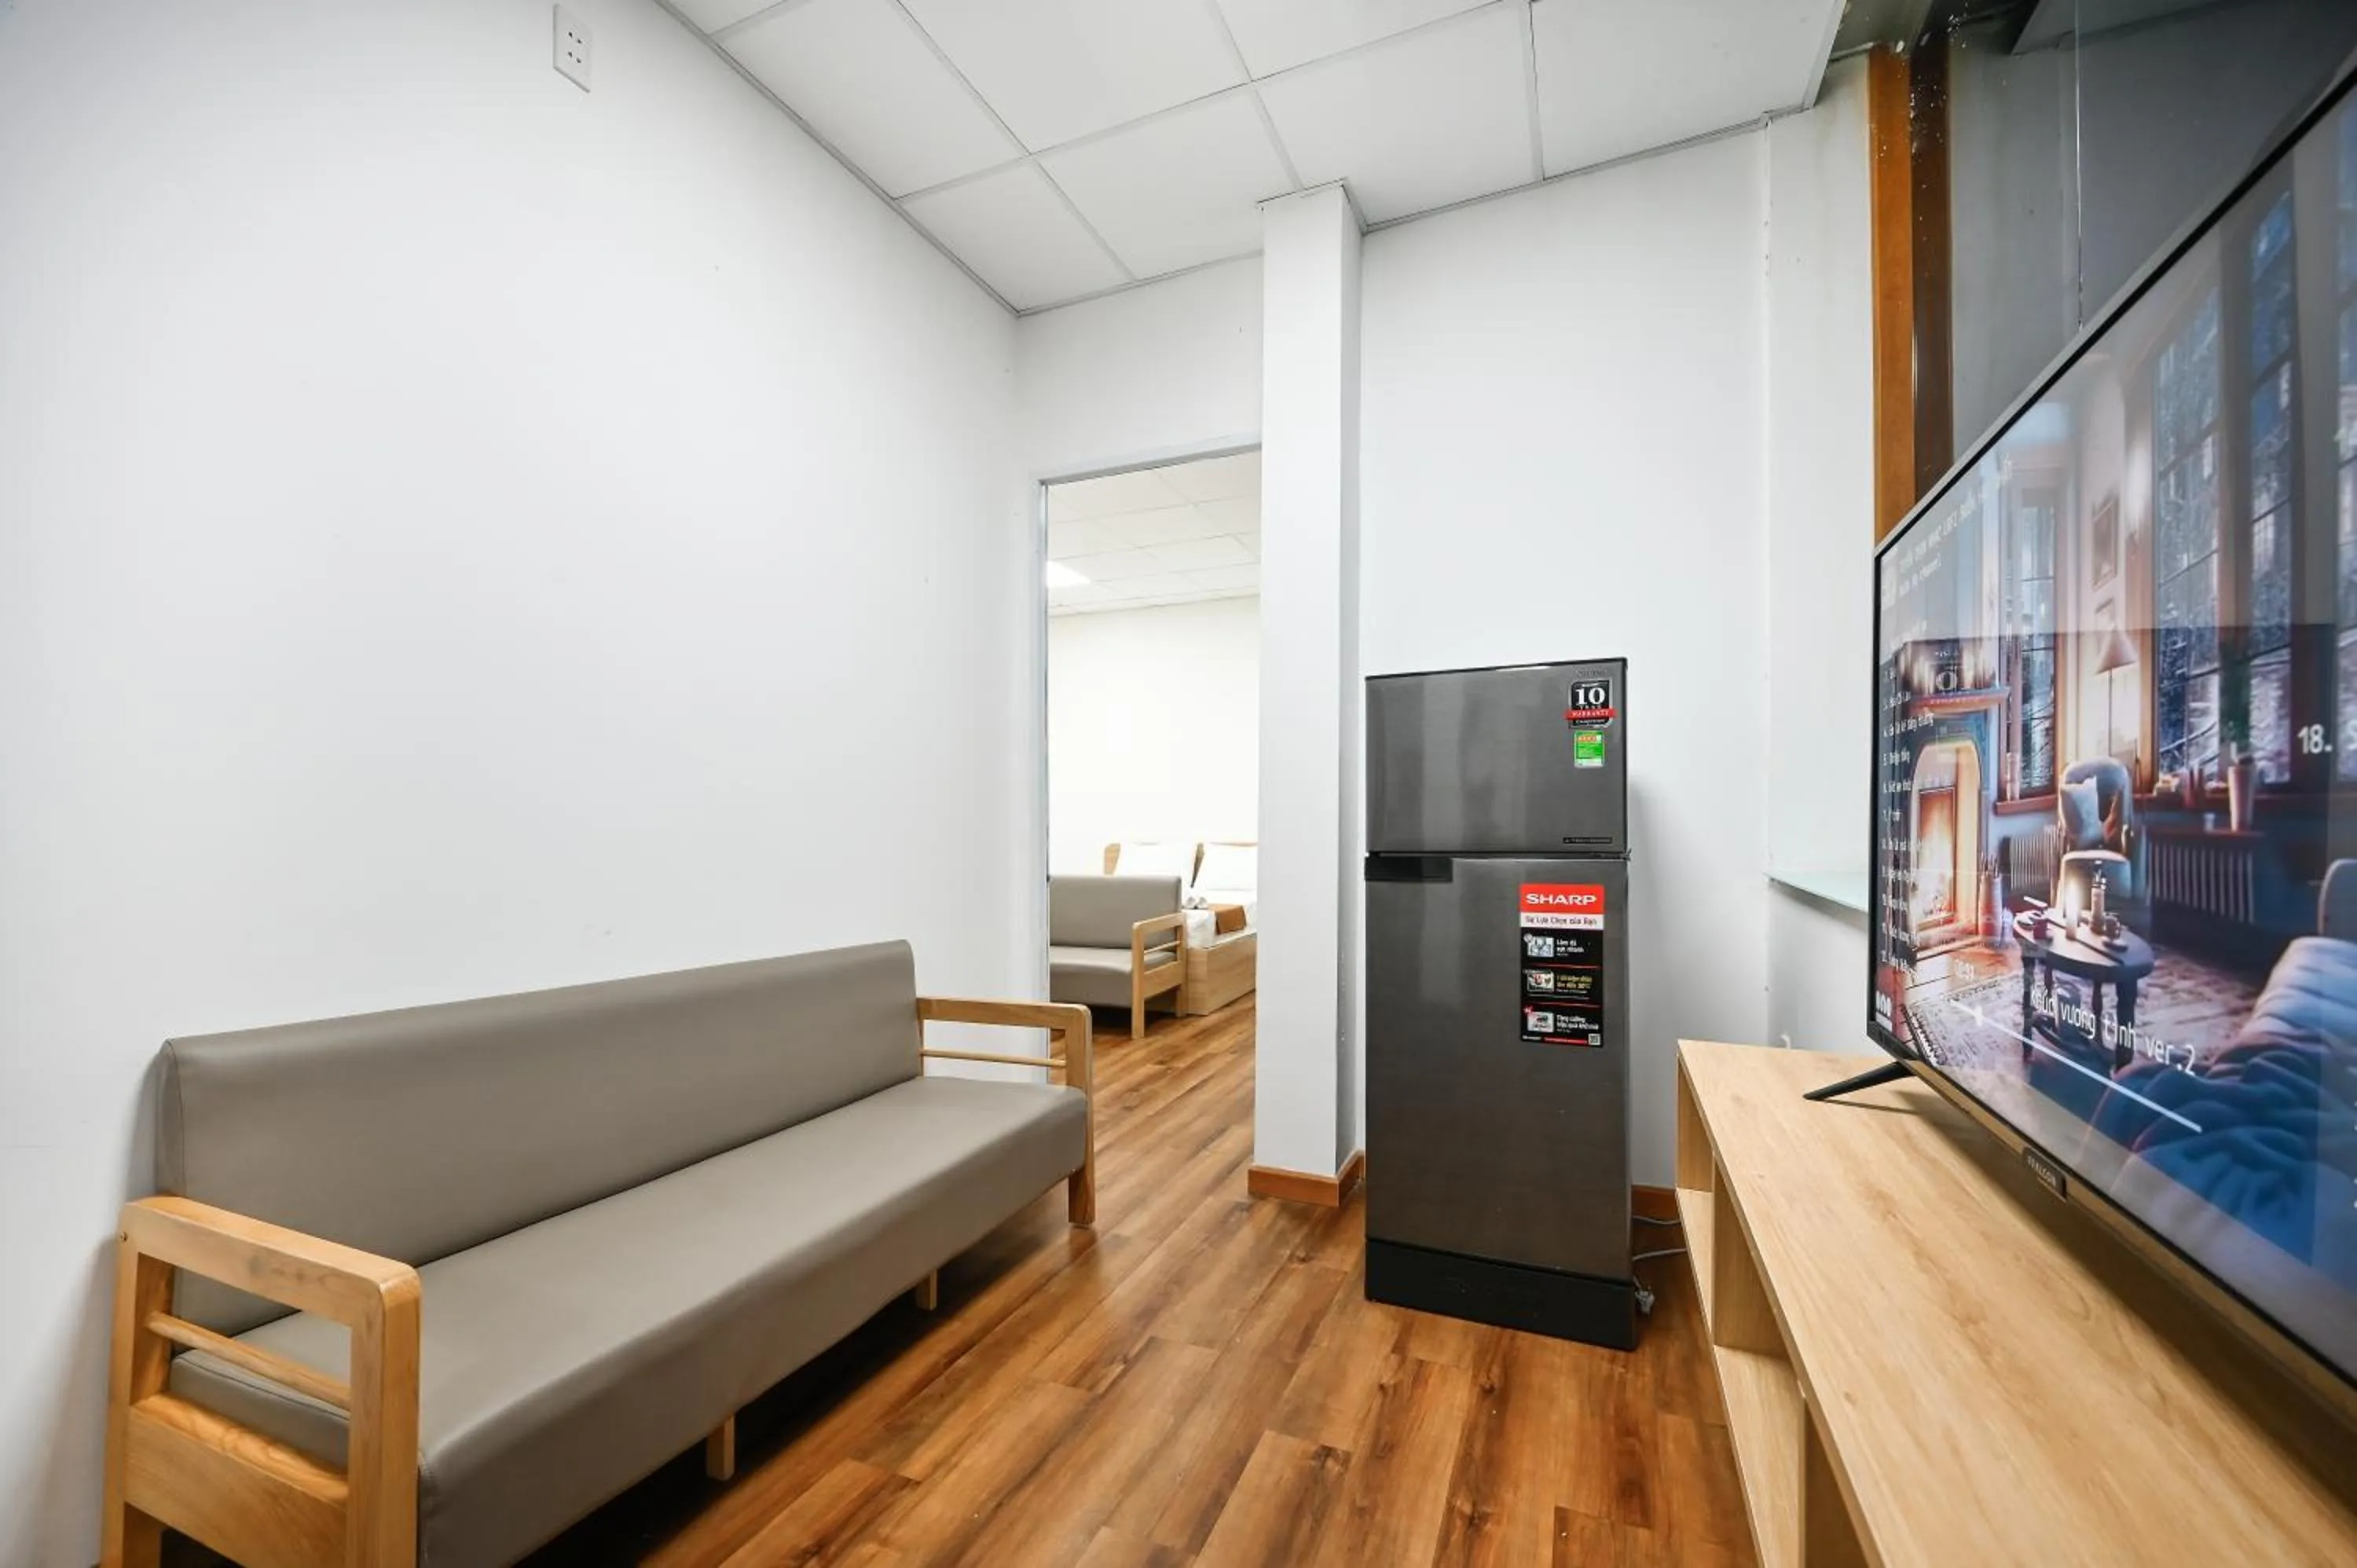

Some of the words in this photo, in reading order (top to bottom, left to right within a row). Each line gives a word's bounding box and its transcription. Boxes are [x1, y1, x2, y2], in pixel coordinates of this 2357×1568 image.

[1575, 687, 1605, 705] 10
[2297, 724, 2333, 754] 18.
[1526, 893, 1597, 905] SHARP
